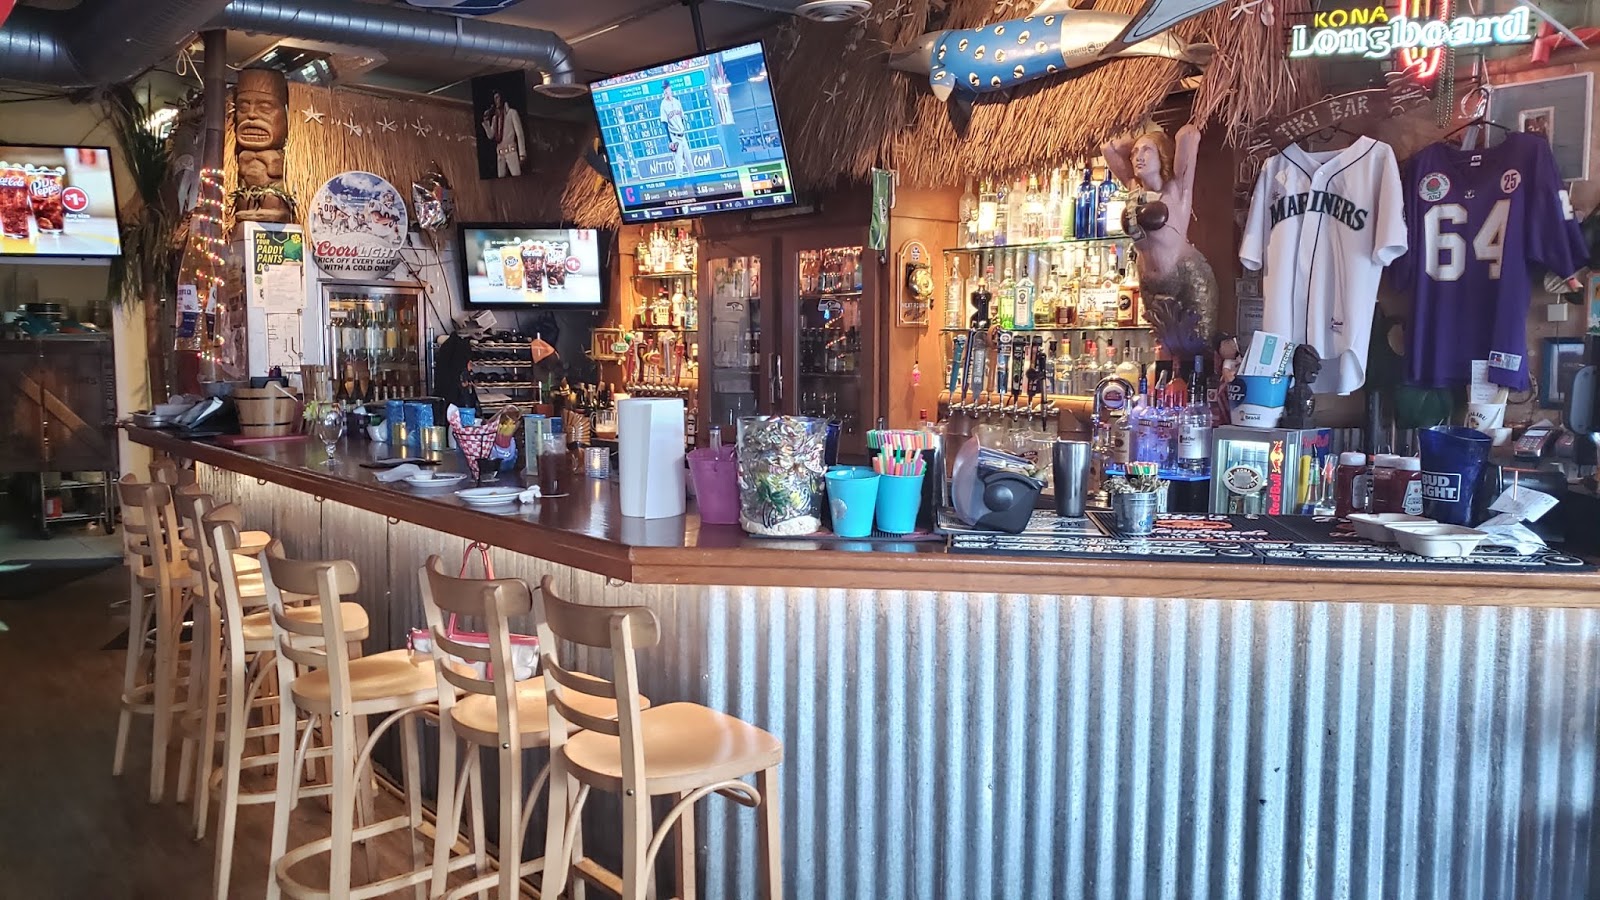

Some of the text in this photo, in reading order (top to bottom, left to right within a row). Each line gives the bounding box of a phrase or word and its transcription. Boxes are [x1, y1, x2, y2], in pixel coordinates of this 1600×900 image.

[1314, 6, 1389, 28] KONA
[1289, 6, 1532, 58] Longboard
[1275, 95, 1370, 140] TIKI BAR
[1504, 172, 1518, 190] 25
[1270, 190, 1368, 231] MARINERS
[256, 245, 284, 254] PADDY
[317, 241, 398, 258] Coors LIGHT
[1424, 199, 1512, 282] 64
[256, 254, 283, 264] PANTS
[1422, 475, 1450, 486] BUD
